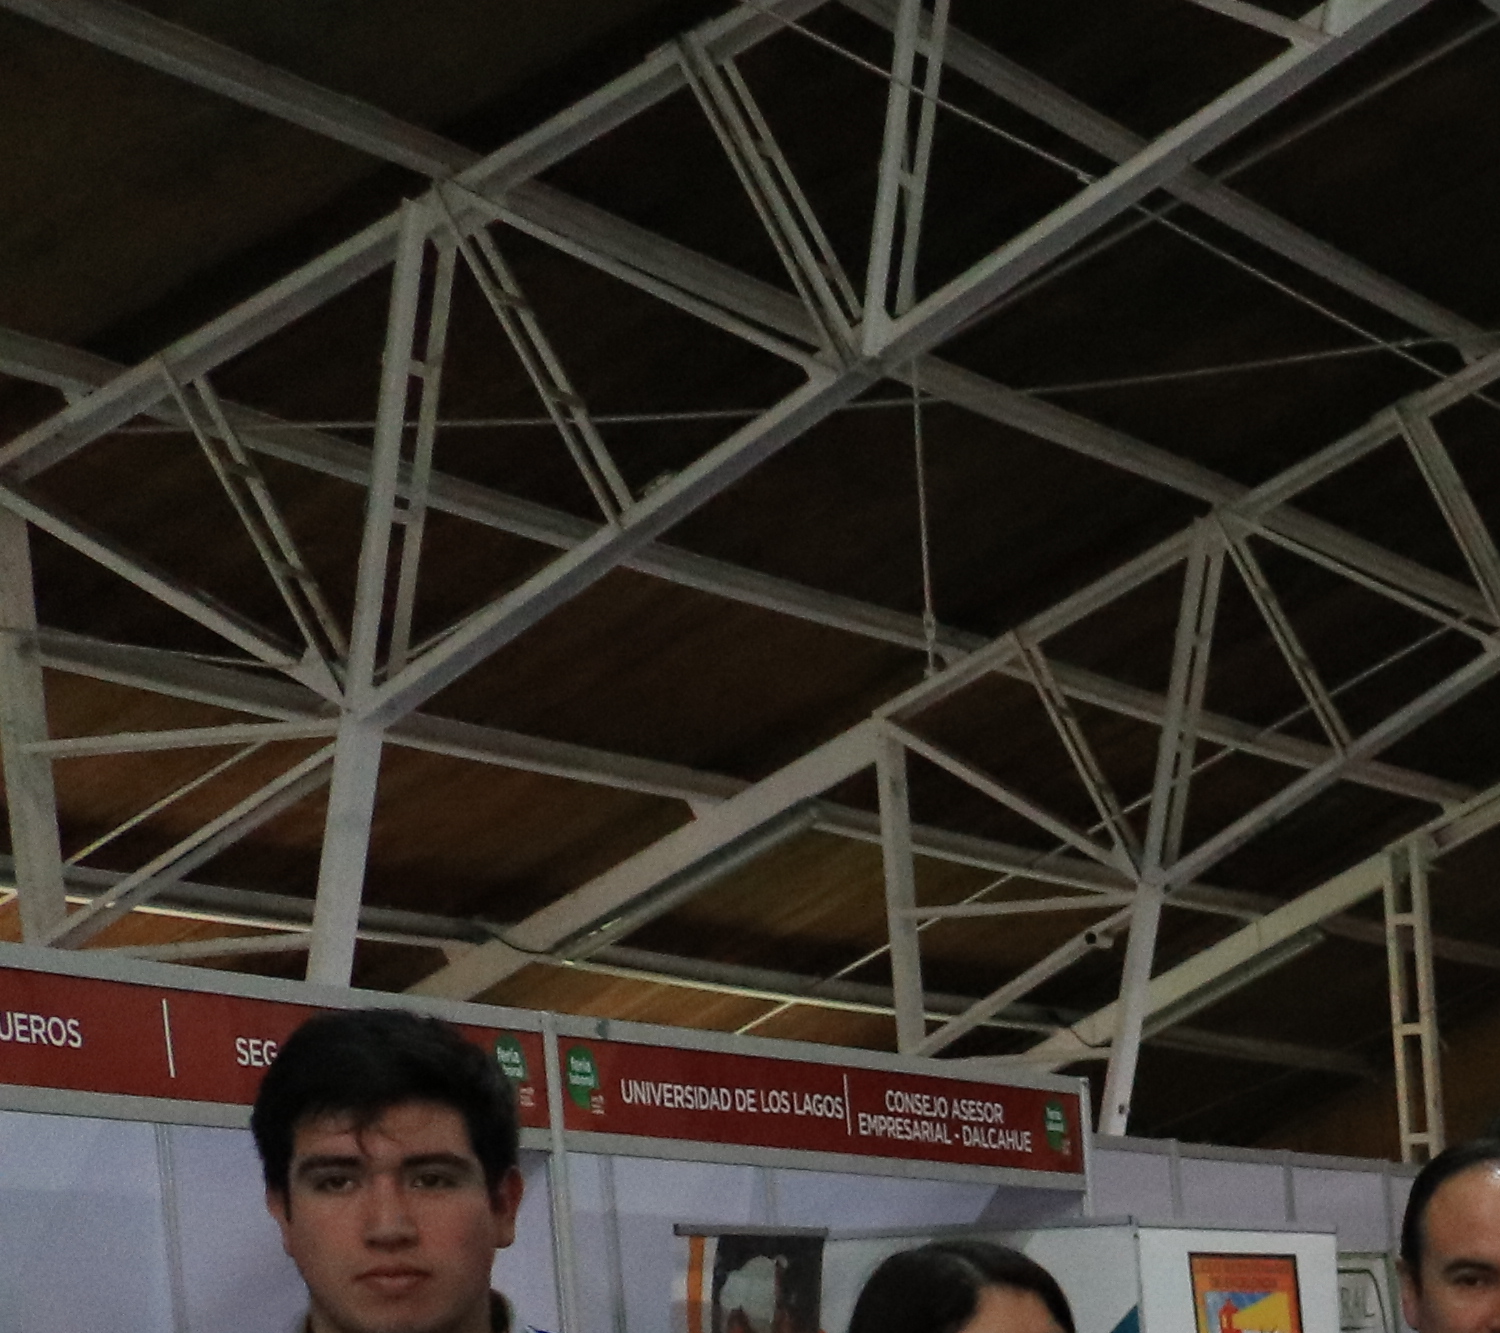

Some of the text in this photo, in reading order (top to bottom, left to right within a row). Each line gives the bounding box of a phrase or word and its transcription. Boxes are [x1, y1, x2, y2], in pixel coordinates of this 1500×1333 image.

[620, 1078, 732, 1112] UNIVERSIDAD
[734, 1087, 758, 1113] DE
[760, 1089, 791, 1114] LOS
[793, 1091, 845, 1120] LAGOS
[884, 1089, 1004, 1124] CONSEJO ASESOR
[857, 1112, 954, 1146] EMPRESARIAL
[962, 1124, 1033, 1153] DALCAHUE
